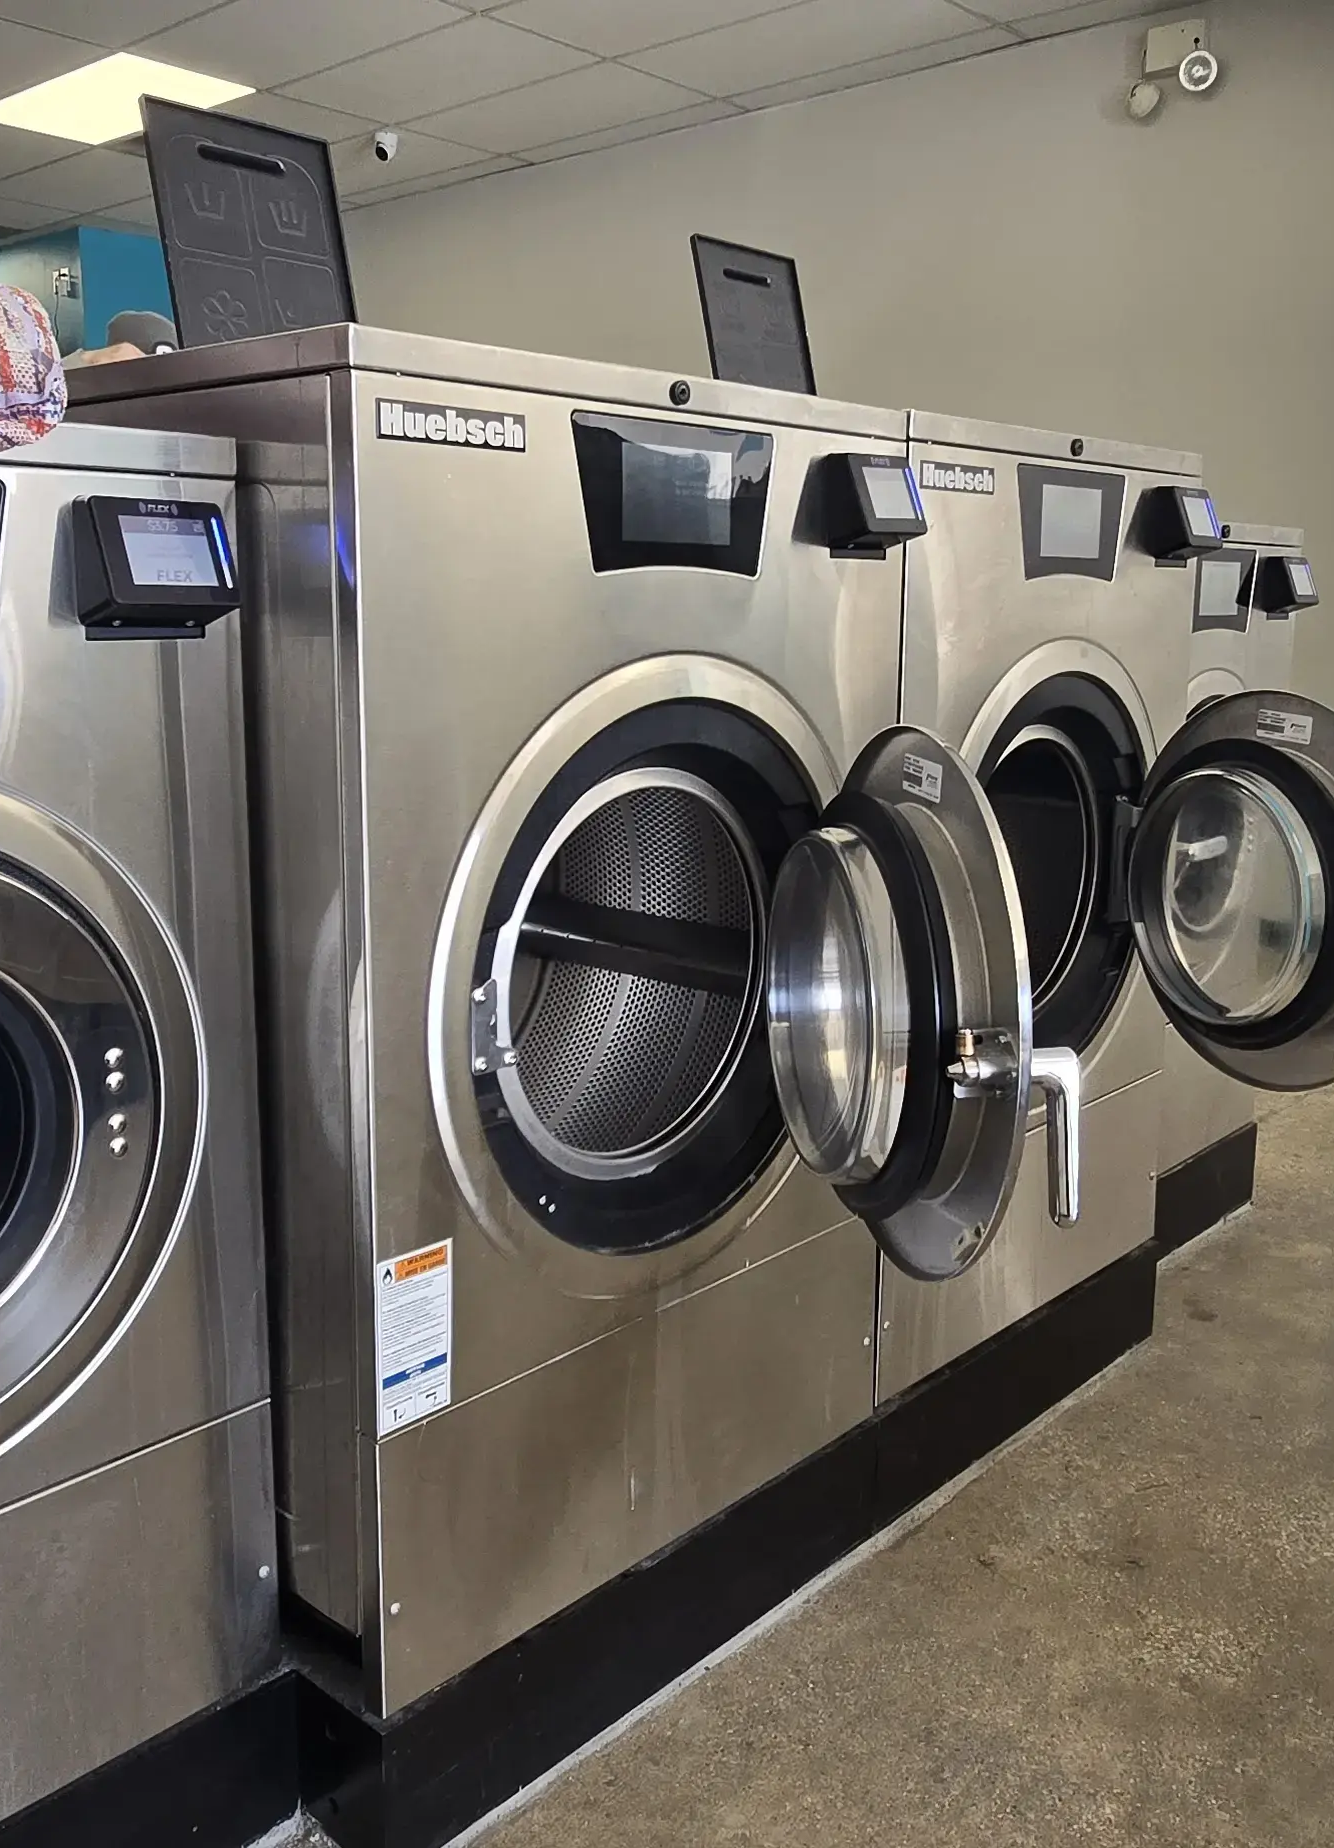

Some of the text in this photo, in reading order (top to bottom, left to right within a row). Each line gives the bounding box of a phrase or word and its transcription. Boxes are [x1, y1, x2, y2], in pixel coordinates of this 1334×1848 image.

[379, 402, 525, 450] Huebsch
[922, 462, 994, 493] Huebsch
[156, 569, 193, 583] FLEX
